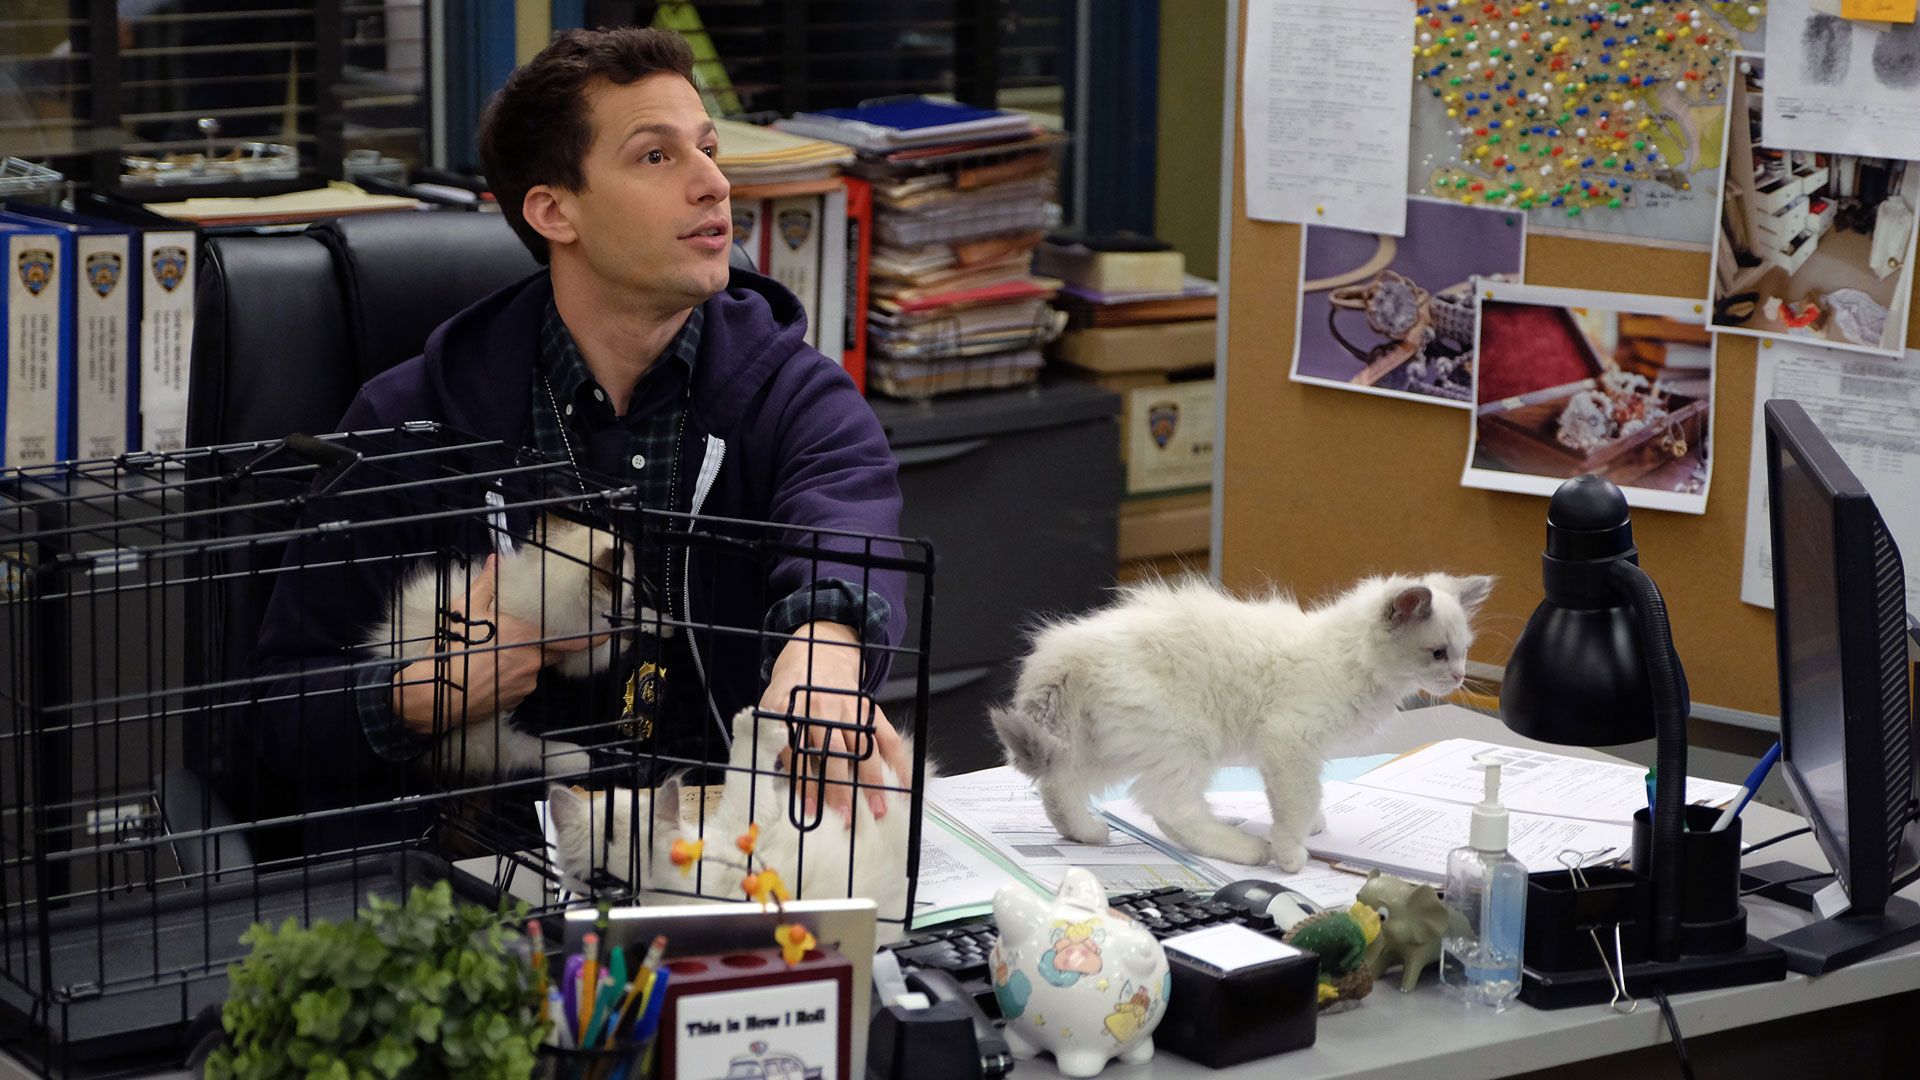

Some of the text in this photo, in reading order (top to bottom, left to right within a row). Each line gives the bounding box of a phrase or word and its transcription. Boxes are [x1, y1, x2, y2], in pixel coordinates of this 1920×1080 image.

[686, 1008, 825, 1037] This is How I Roll
